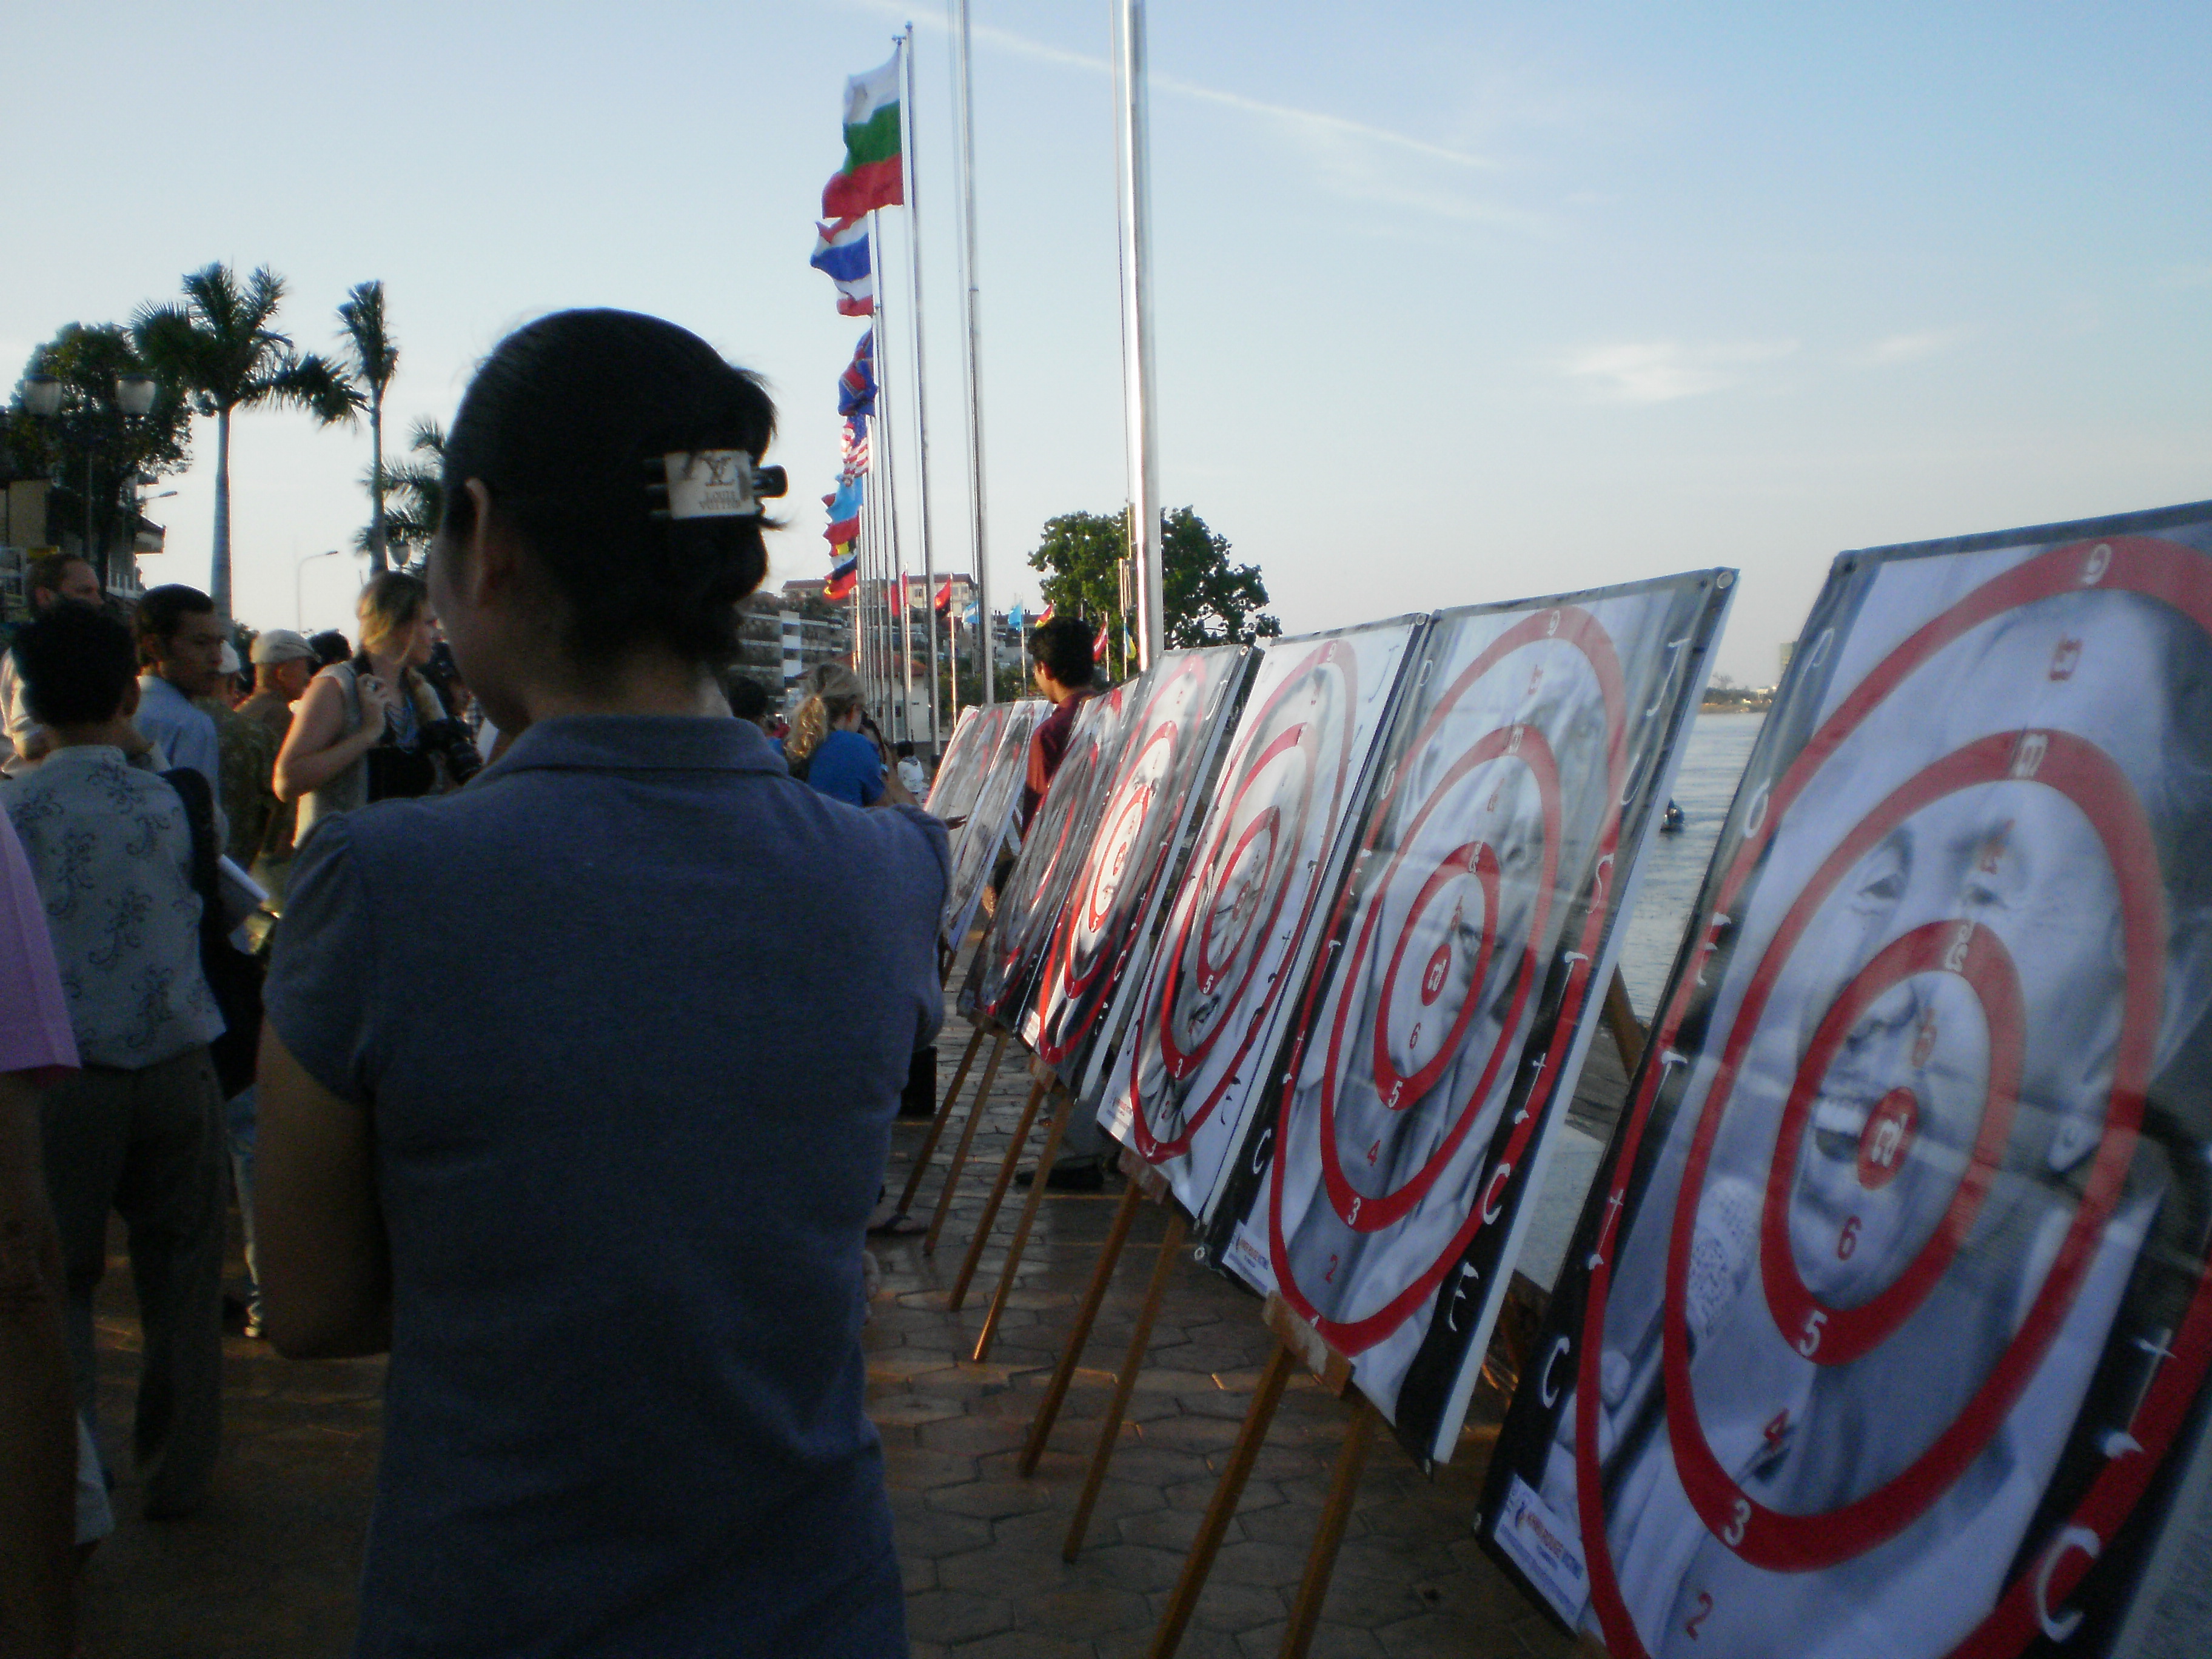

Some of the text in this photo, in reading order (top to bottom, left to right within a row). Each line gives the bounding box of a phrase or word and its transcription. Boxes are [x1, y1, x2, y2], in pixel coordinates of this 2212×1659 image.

[1203, 974, 1214, 994] 5
[1409, 1022, 1422, 1050] 6
[1388, 1081, 1403, 1108] 5
[1367, 1140, 1381, 1167] 4
[1348, 1197, 1362, 1225] 3
[1838, 1216, 1861, 1261] 6
[1325, 1254, 1338, 1284] 2
[1799, 1310, 1828, 1357] 5
[1765, 1409, 1790, 1452] 4
[1724, 1499, 1752, 1546] 3
[1686, 1592, 1713, 1640] 2
